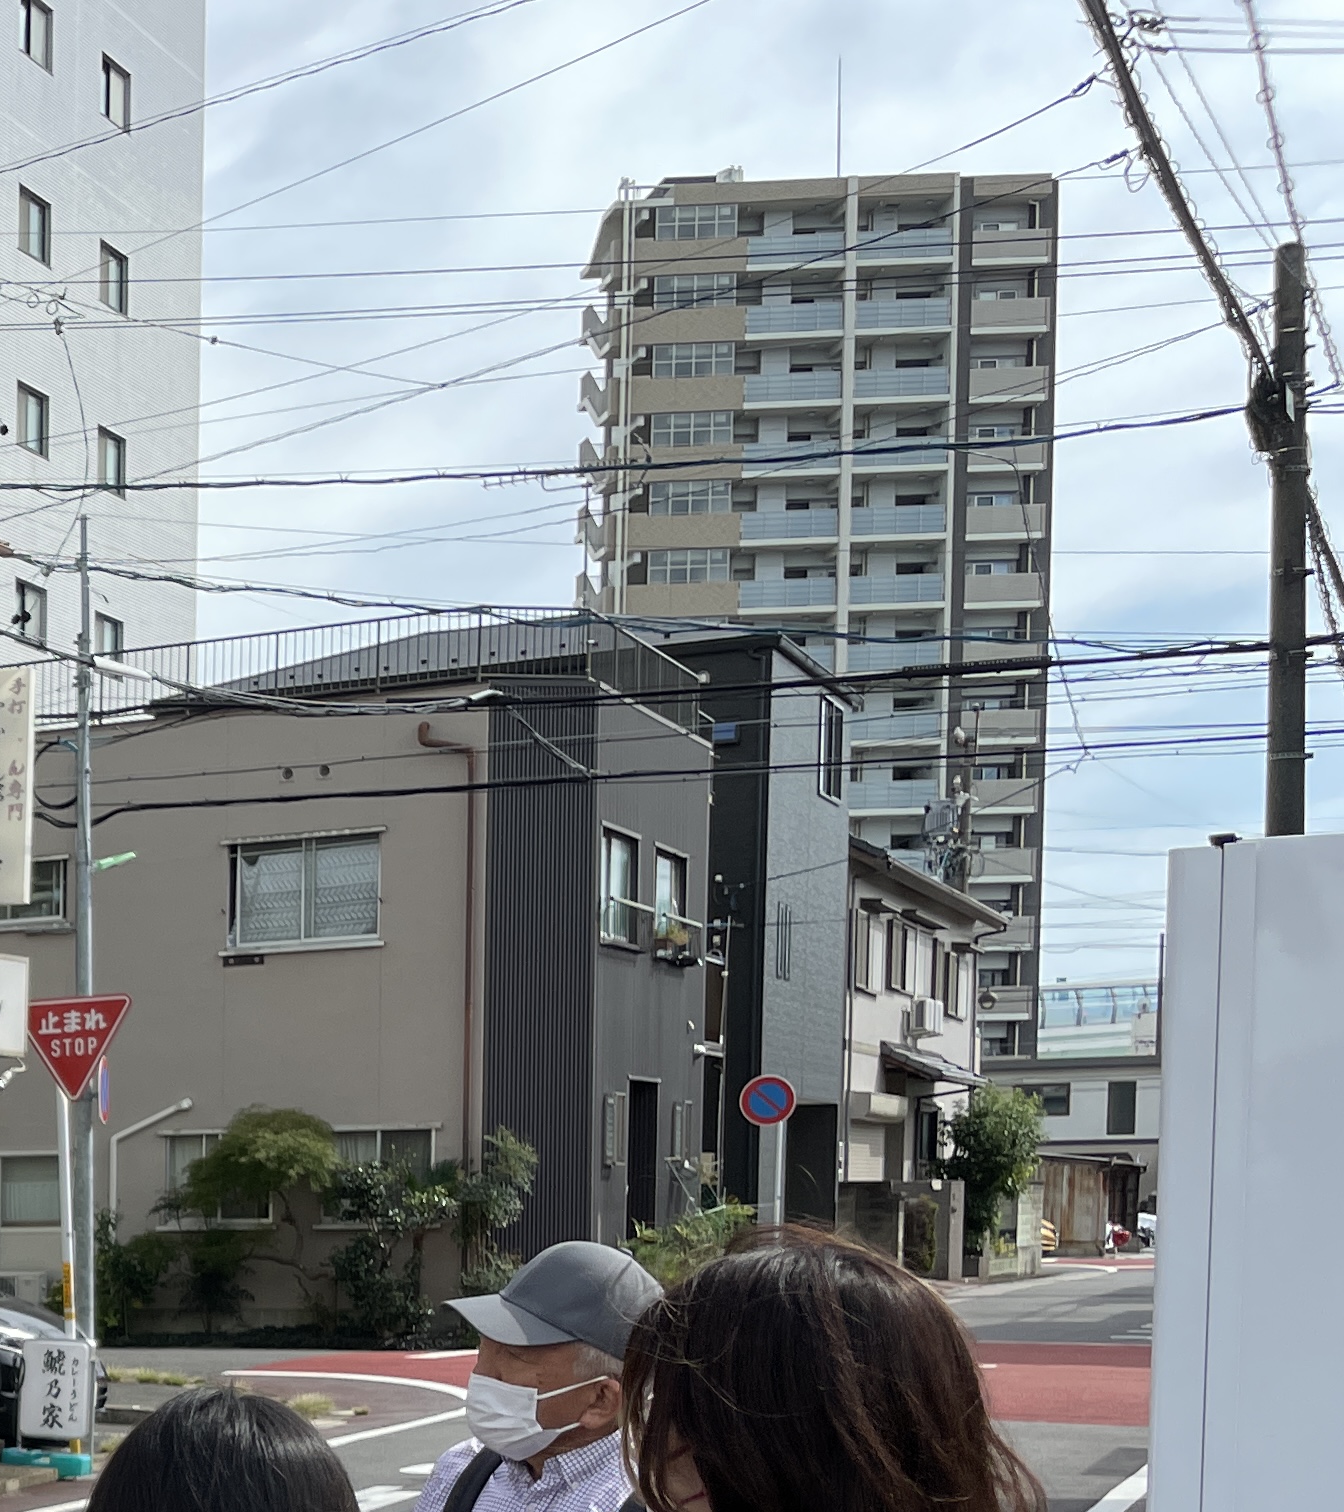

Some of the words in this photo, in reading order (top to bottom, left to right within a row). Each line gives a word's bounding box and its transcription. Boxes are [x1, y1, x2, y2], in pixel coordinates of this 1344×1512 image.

[37, 1007, 108, 1037] 止まれ
[50, 1037, 98, 1059] STOP
[67, 1357, 79, 1422] カレーうどん
